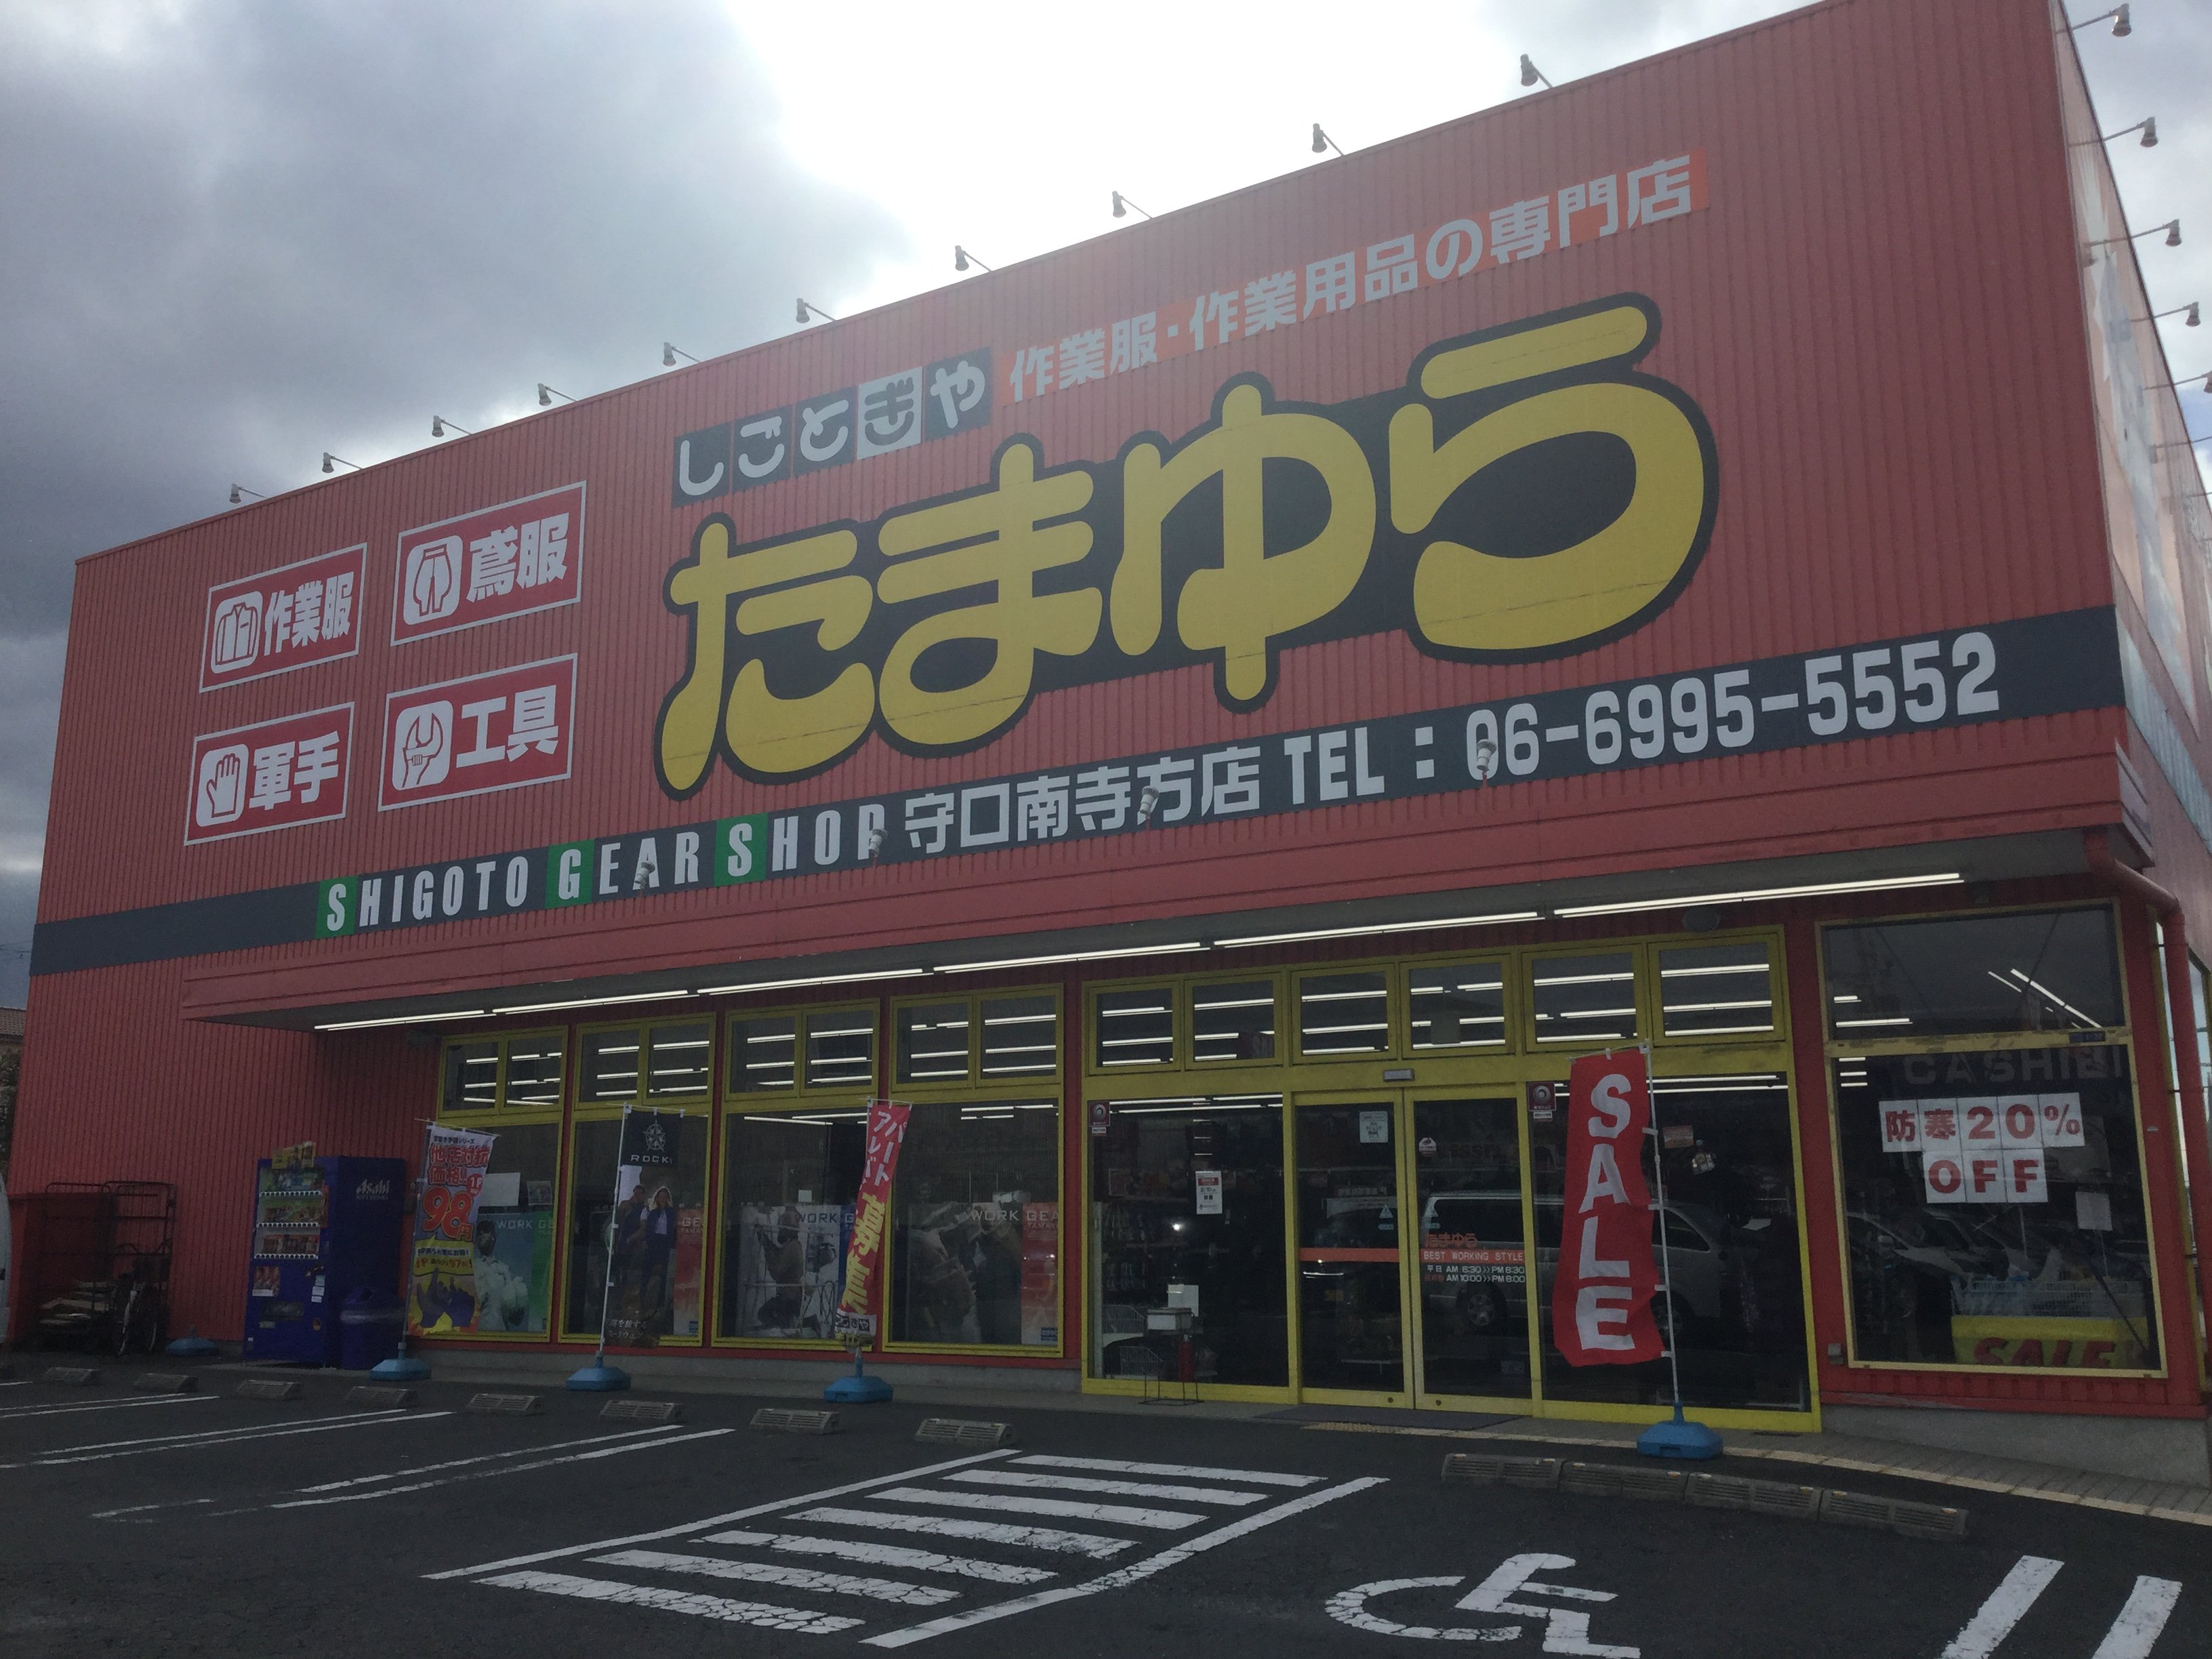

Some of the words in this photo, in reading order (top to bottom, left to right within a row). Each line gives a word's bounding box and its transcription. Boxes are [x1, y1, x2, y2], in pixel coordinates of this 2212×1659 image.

[1009, 155, 1692, 402] 作業服・作業用品の専門店
[679, 360, 986, 496] しごとぎや
[466, 512, 570, 603] 鳶服
[264, 571, 354, 656] 作業服
[455, 684, 560, 769] 工具
[905, 745, 1262, 855] 守口南寺方店
[1466, 631, 2000, 781] 06-6995-5552
[248, 731, 340, 811] 軍手
[326, 856, 529, 932] SHIGOTO
[558, 832, 699, 899] GEAR
[728, 803, 886, 878] SHOP
[1885, 1103, 2080, 1143] 防寒20%
[970, 1210, 1020, 1221] WORK
[1575, 1073, 1636, 1351] SALE
[1928, 1159, 2040, 1194] OFF
[497, 1219, 533, 1229] WORK
[1424, 1252, 1445, 1261] BEST
[1452, 1252, 1489, 1261] WORKING
[1496, 1252, 1523, 1261] STYLE
